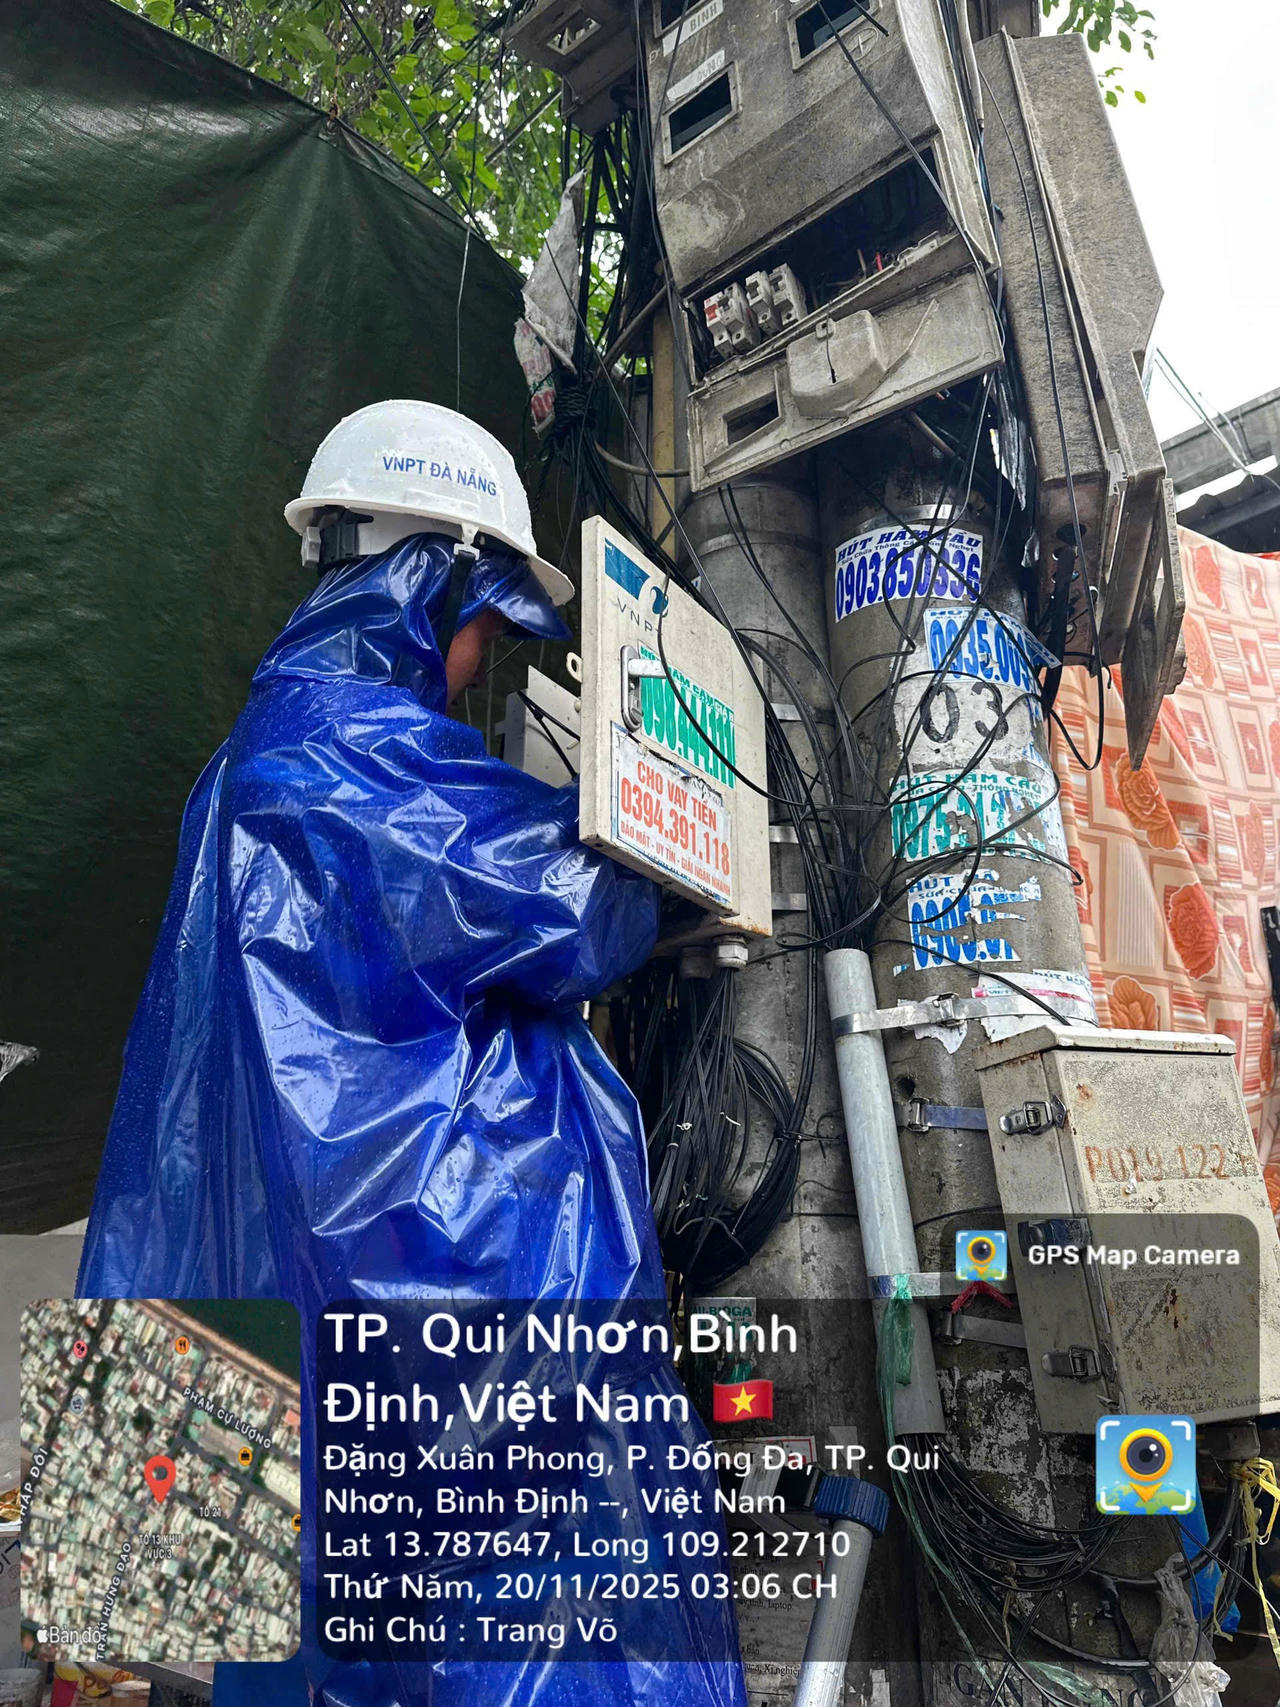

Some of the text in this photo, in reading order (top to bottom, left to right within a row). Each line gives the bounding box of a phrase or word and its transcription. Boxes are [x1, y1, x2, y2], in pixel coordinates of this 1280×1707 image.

[382, 455, 497, 497] VNPT ĐÀ NẴNG
[837, 537, 874, 563] HÚT
[836, 547, 982, 620] 0903.850336
[919, 681, 1009, 744] 03
[637, 760, 663, 795] CHO
[668, 781, 688, 812] VAY
[620, 776, 730, 877] 0394.391.118
[656, 841, 665, 856] UY
